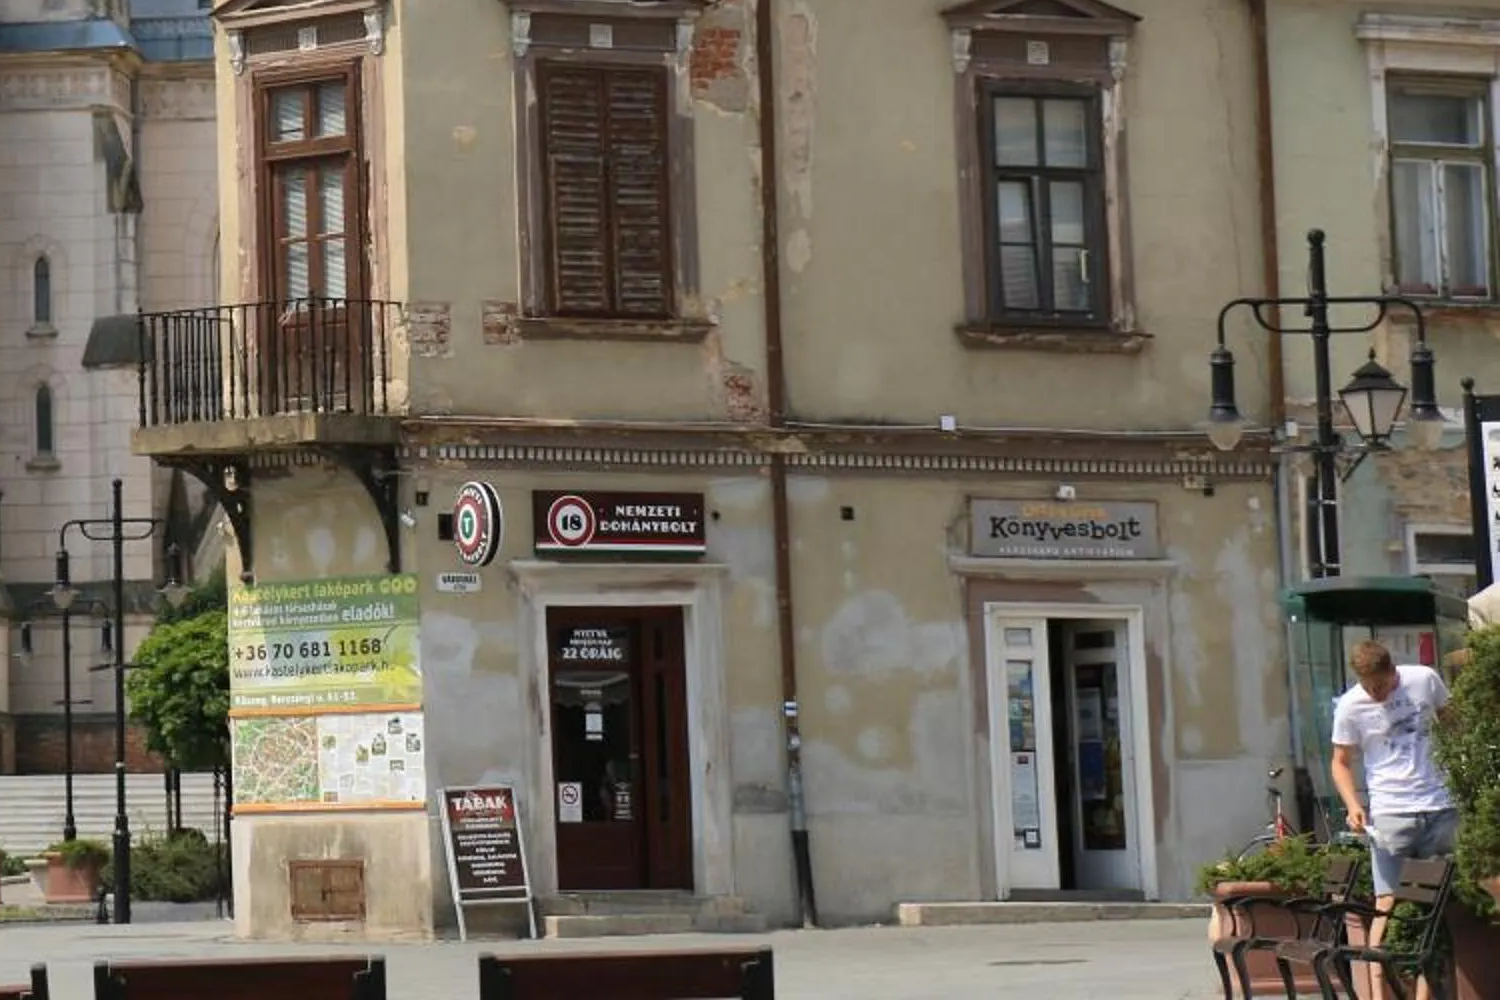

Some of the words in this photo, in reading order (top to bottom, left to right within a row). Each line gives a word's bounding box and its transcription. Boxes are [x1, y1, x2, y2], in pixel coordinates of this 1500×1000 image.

[615, 505, 681, 517] NEMZETI
[561, 514, 583, 531] 18
[600, 518, 697, 533] DOHÁNYBOLT
[989, 514, 1141, 541] Könyvesbolt
[342, 604, 394, 622] eladók!
[235, 645, 267, 660] +36
[272, 643, 293, 659] 70
[299, 641, 331, 658] 681
[338, 638, 381, 655] 1168
[562, 647, 577, 659] 22
[451, 795, 508, 811] TABAK
